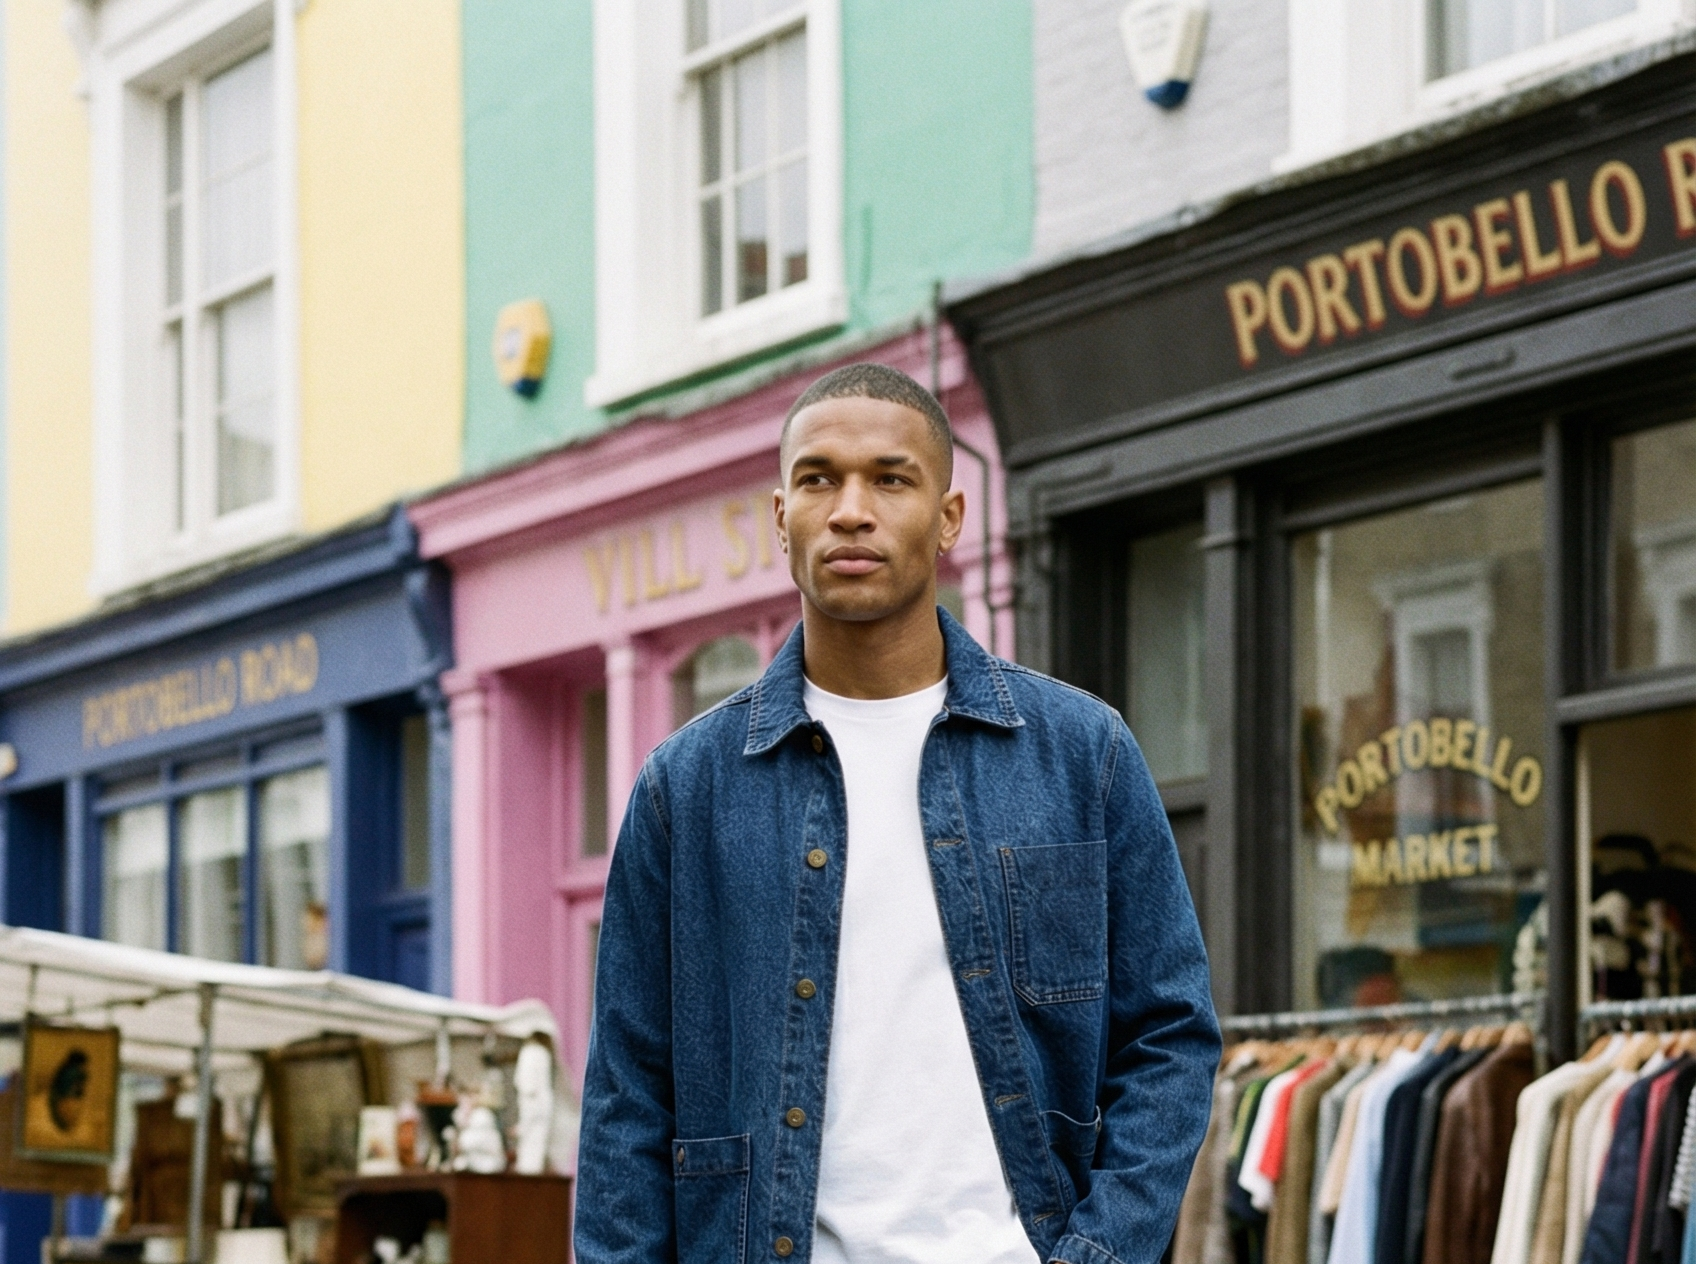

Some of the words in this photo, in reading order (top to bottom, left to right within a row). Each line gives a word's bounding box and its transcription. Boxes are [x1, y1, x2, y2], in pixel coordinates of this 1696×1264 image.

[1227, 160, 1648, 369] PORTOBELLO
[583, 517, 702, 612] VILL
[1315, 717, 1543, 834] PORTOBELLO
[1351, 824, 1499, 887] MARKET
